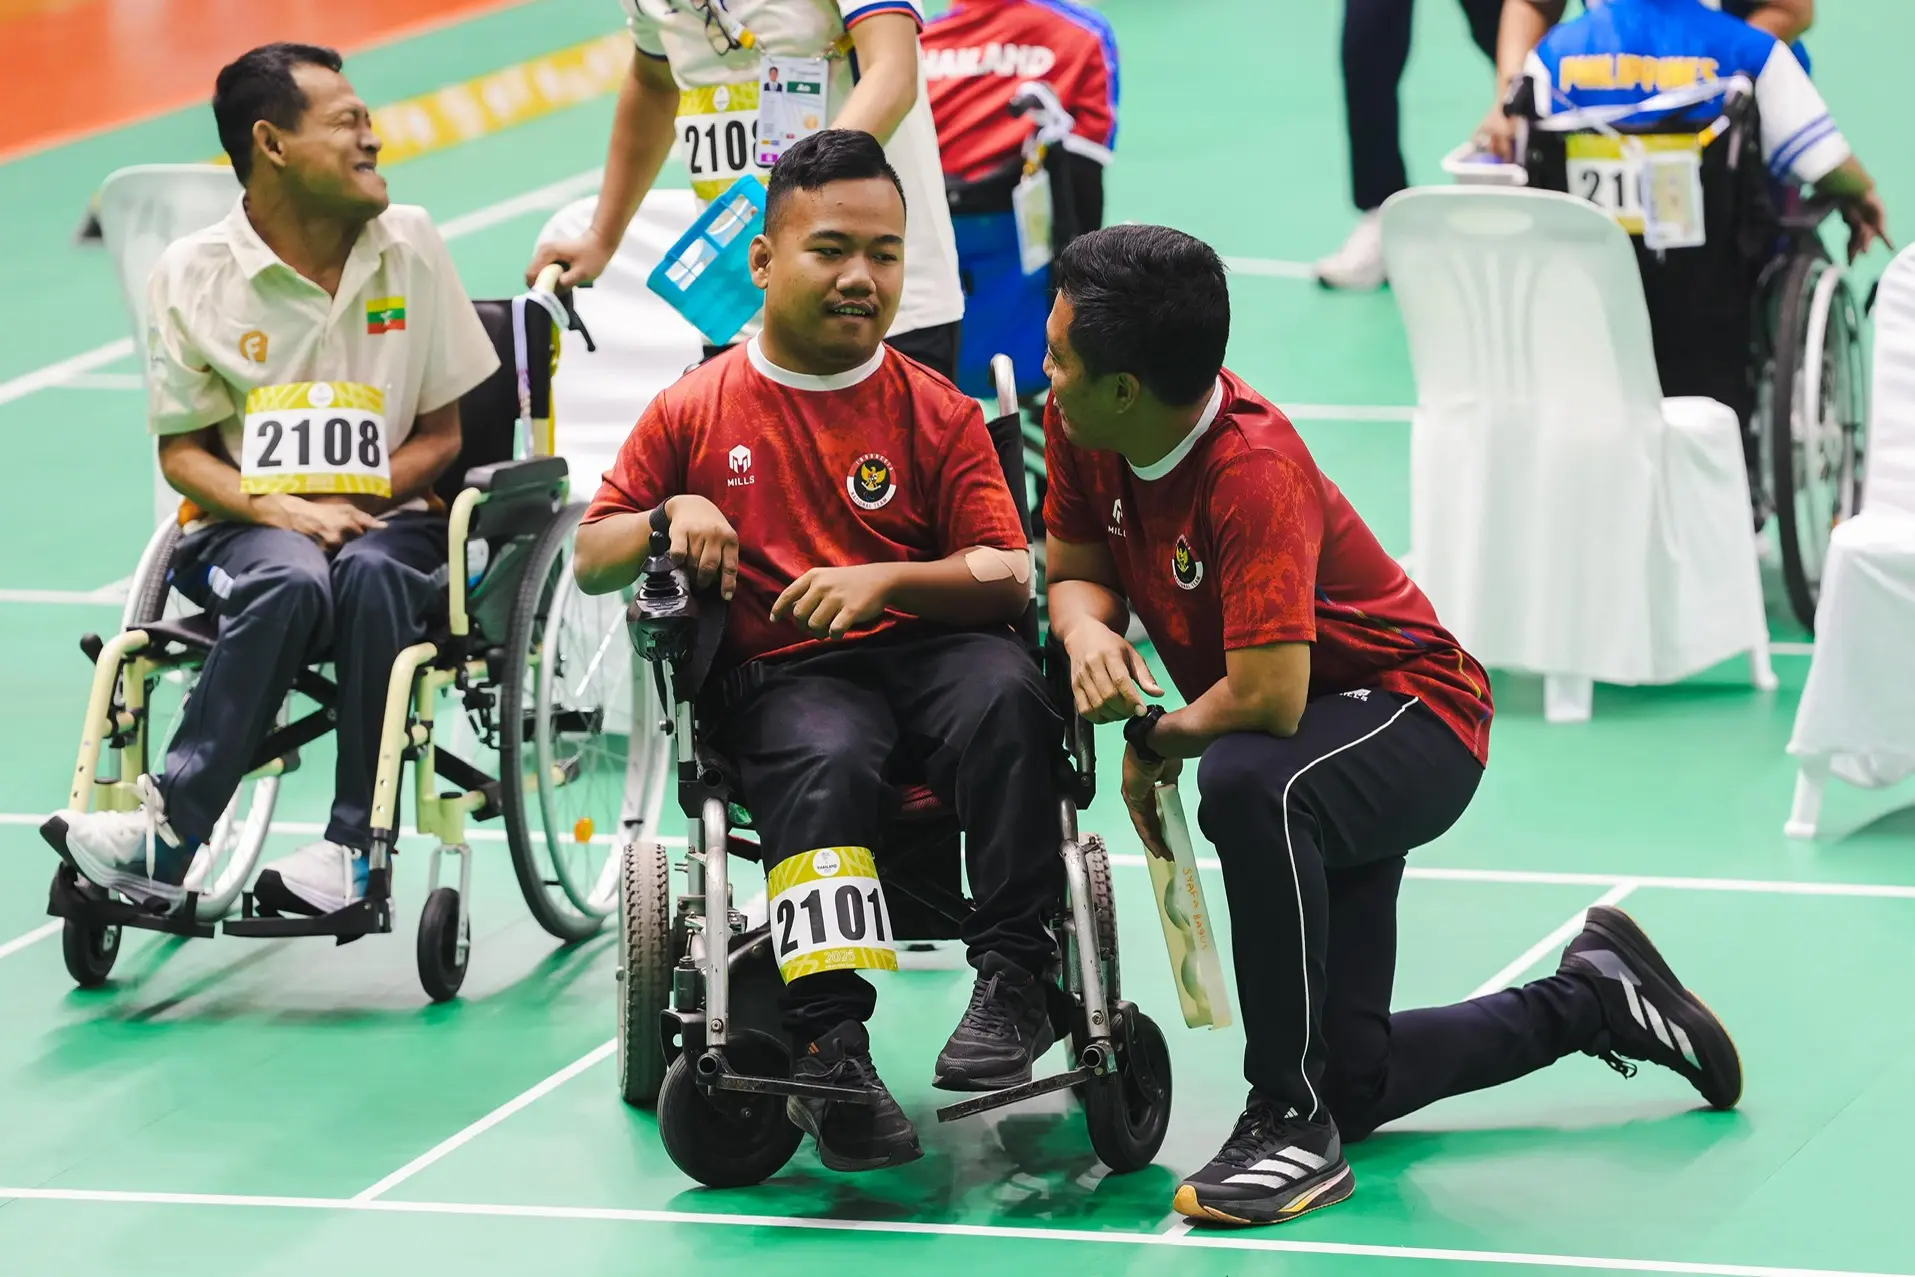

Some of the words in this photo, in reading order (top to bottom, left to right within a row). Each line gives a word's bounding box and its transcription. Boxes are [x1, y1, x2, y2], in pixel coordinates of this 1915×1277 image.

[922, 42, 1055, 79] HAILAND
[685, 120, 758, 174] 210
[1582, 169, 1643, 208] 21
[257, 417, 380, 468] 2108
[727, 475, 755, 487] MILLS
[850, 491, 872, 509] NATIONAL
[874, 498, 888, 508] TEAM
[1107, 525, 1127, 538] MILL
[777, 885, 886, 958] 2101
[824, 949, 856, 963] 2025
